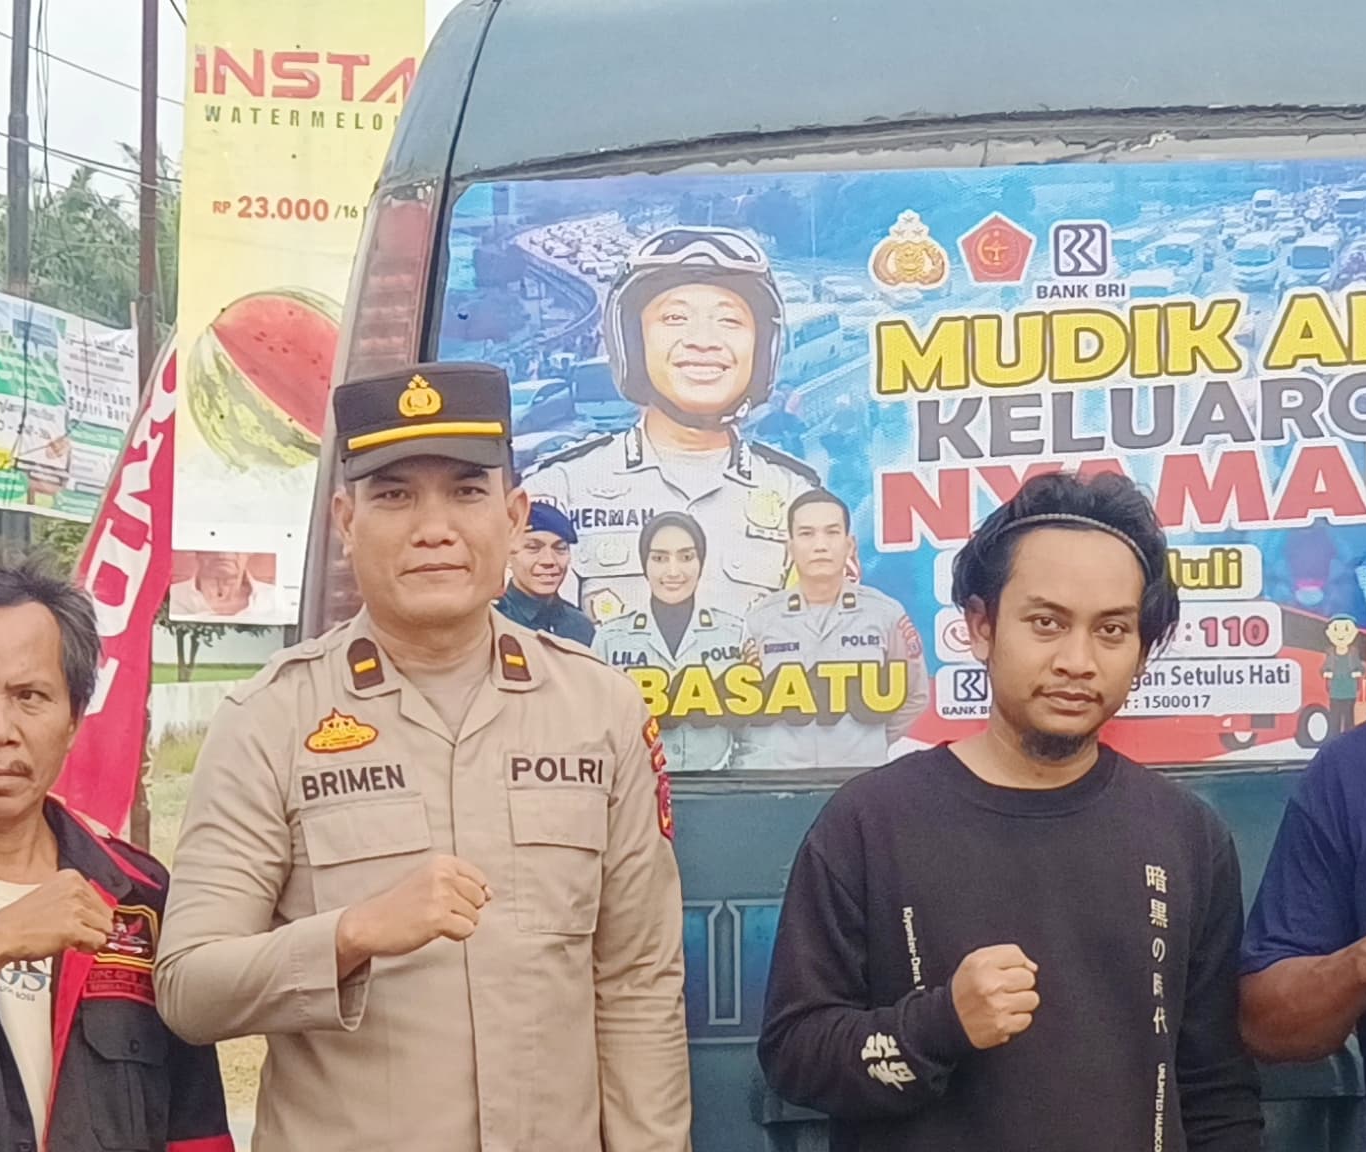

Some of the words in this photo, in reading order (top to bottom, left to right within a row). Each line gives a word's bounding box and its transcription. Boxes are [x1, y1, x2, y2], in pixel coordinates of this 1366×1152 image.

[205, 104, 398, 131] WATERMELO
[237, 195, 329, 222] 23.000
[1036, 283, 1089, 300] BANK
[1096, 282, 1126, 299] BRI
[876, 298, 1242, 394] MUDIK
[1199, 616, 1270, 649] 110
[612, 650, 648, 666] LILA
[1171, 663, 1245, 686] Setulus
[1249, 663, 1291, 685] Hati
[1144, 695, 1211, 709] 1500017
[301, 764, 406, 801] BRIMEN
[510, 756, 603, 785] POLRI
